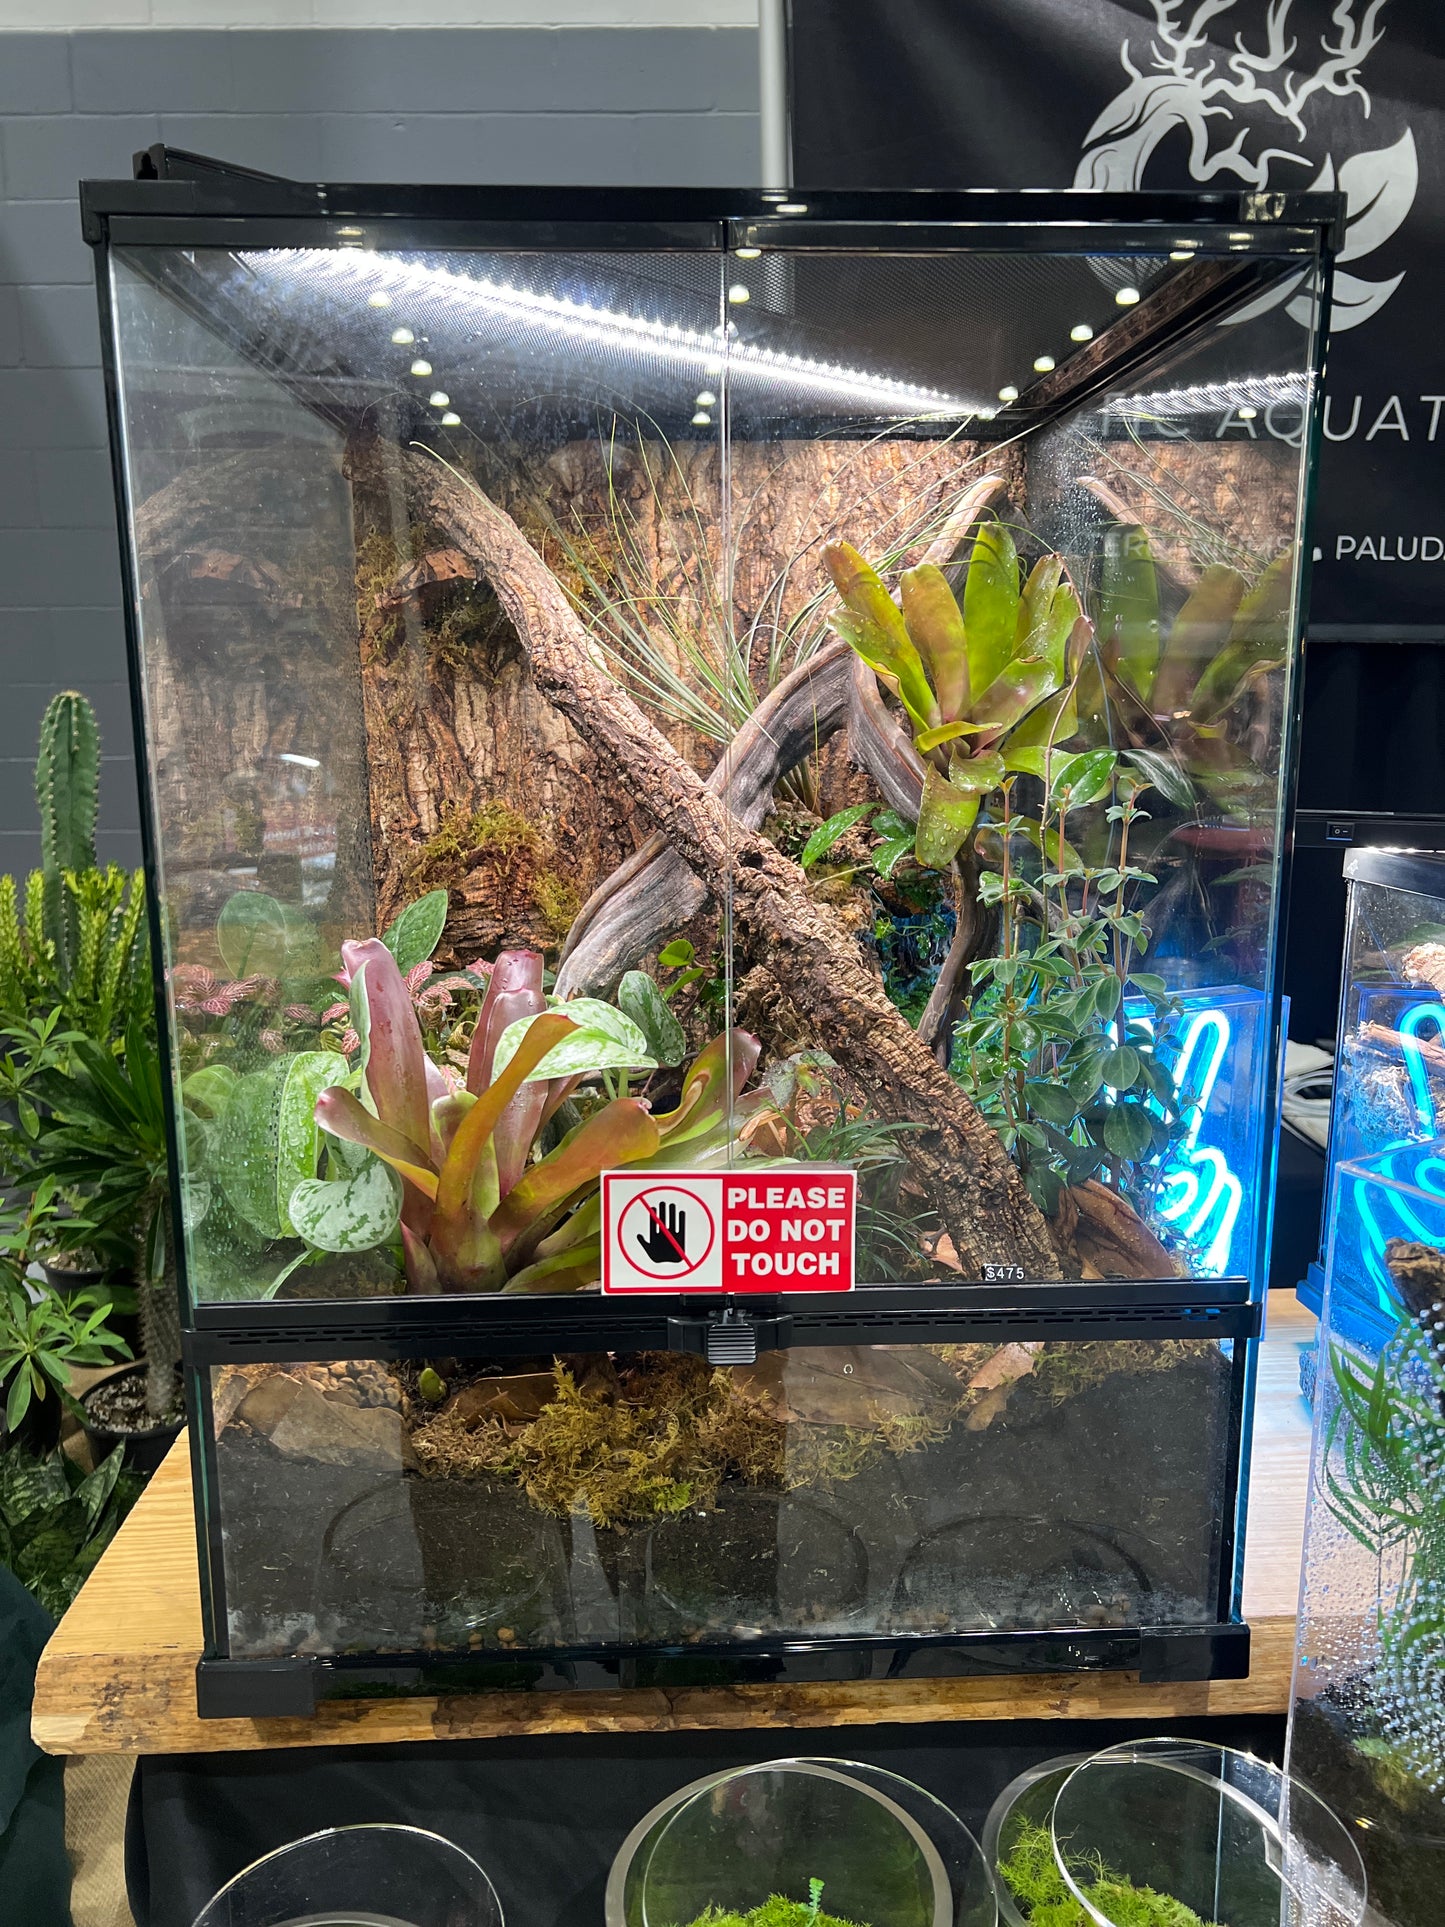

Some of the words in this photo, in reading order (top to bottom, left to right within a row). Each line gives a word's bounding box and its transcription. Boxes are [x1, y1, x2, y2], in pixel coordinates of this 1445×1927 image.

[1335, 535, 1445, 561] PALUD
[727, 1187, 846, 1209] PLEASE
[727, 1219, 771, 1242] DO
[780, 1219, 846, 1242] NOT
[731, 1252, 840, 1276] TOUCH
[986, 1266, 1025, 1280] $475
